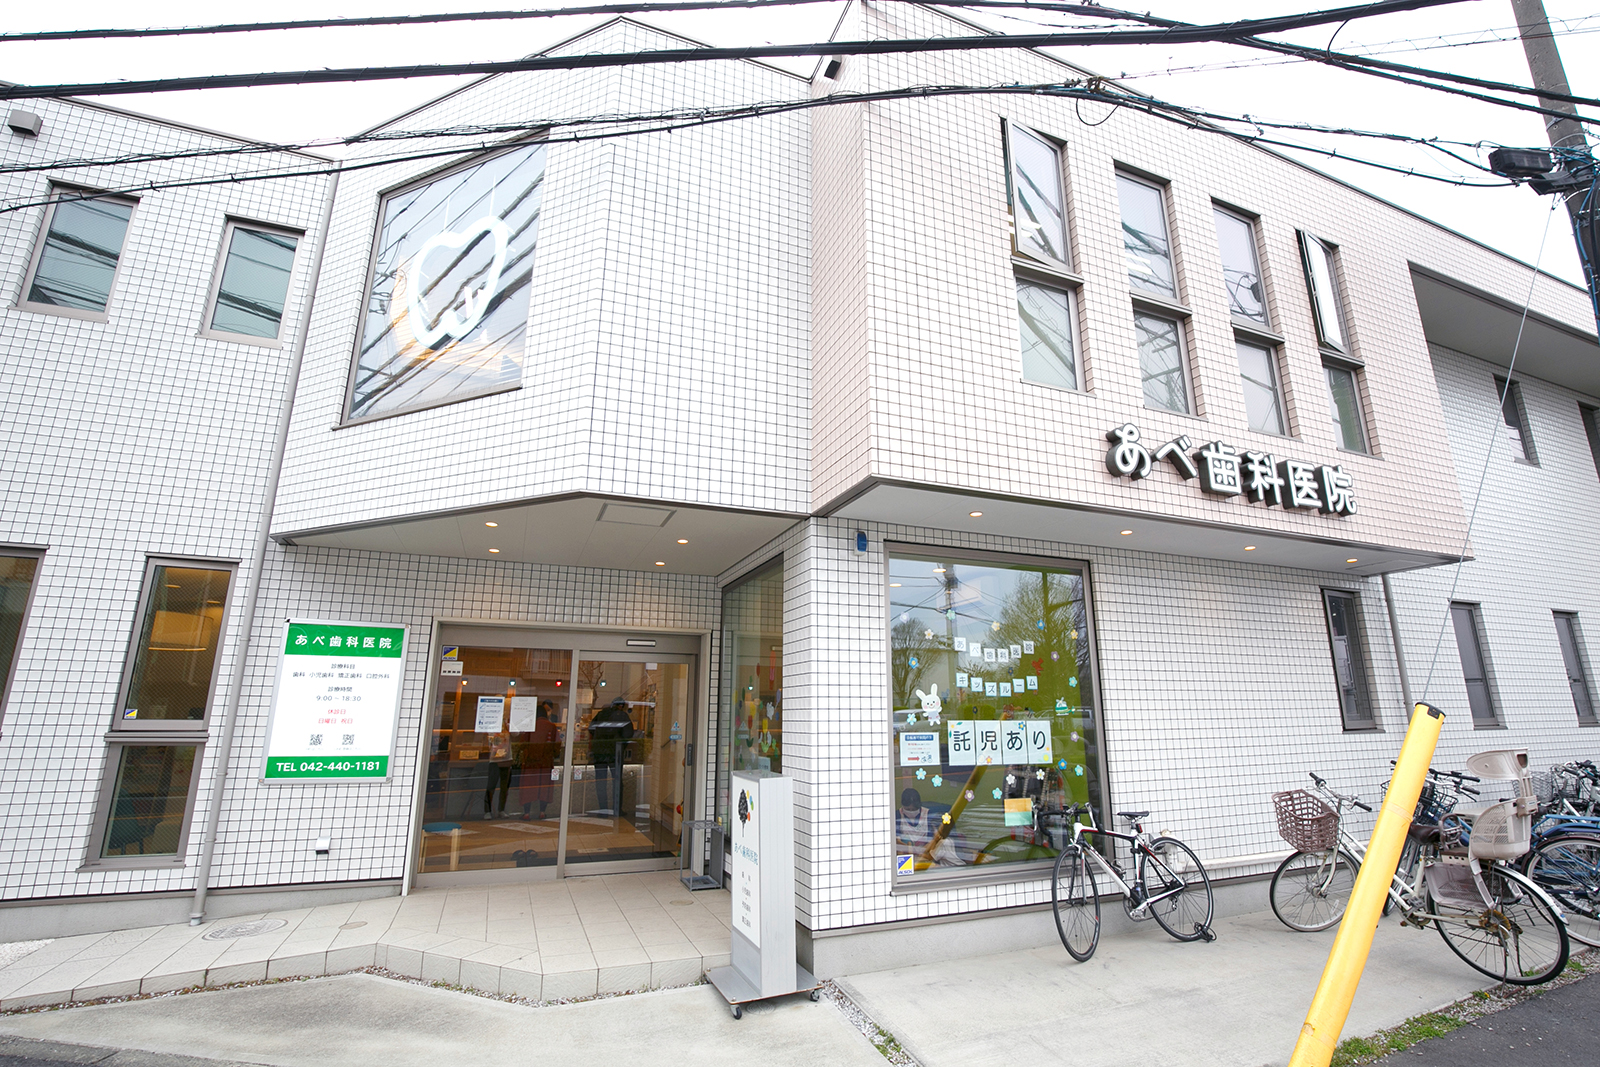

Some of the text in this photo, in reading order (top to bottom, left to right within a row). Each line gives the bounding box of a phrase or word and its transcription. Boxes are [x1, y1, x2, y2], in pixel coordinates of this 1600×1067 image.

[1107, 423, 1357, 516] あべ歯科医院
[295, 634, 392, 649] あべ歯科医院
[957, 640, 1033, 661] あべ歯科医院
[958, 676, 1036, 694] キッズルーム
[953, 730, 1046, 752] 託児あり
[276, 761, 380, 772] TEL 042-440-1181
